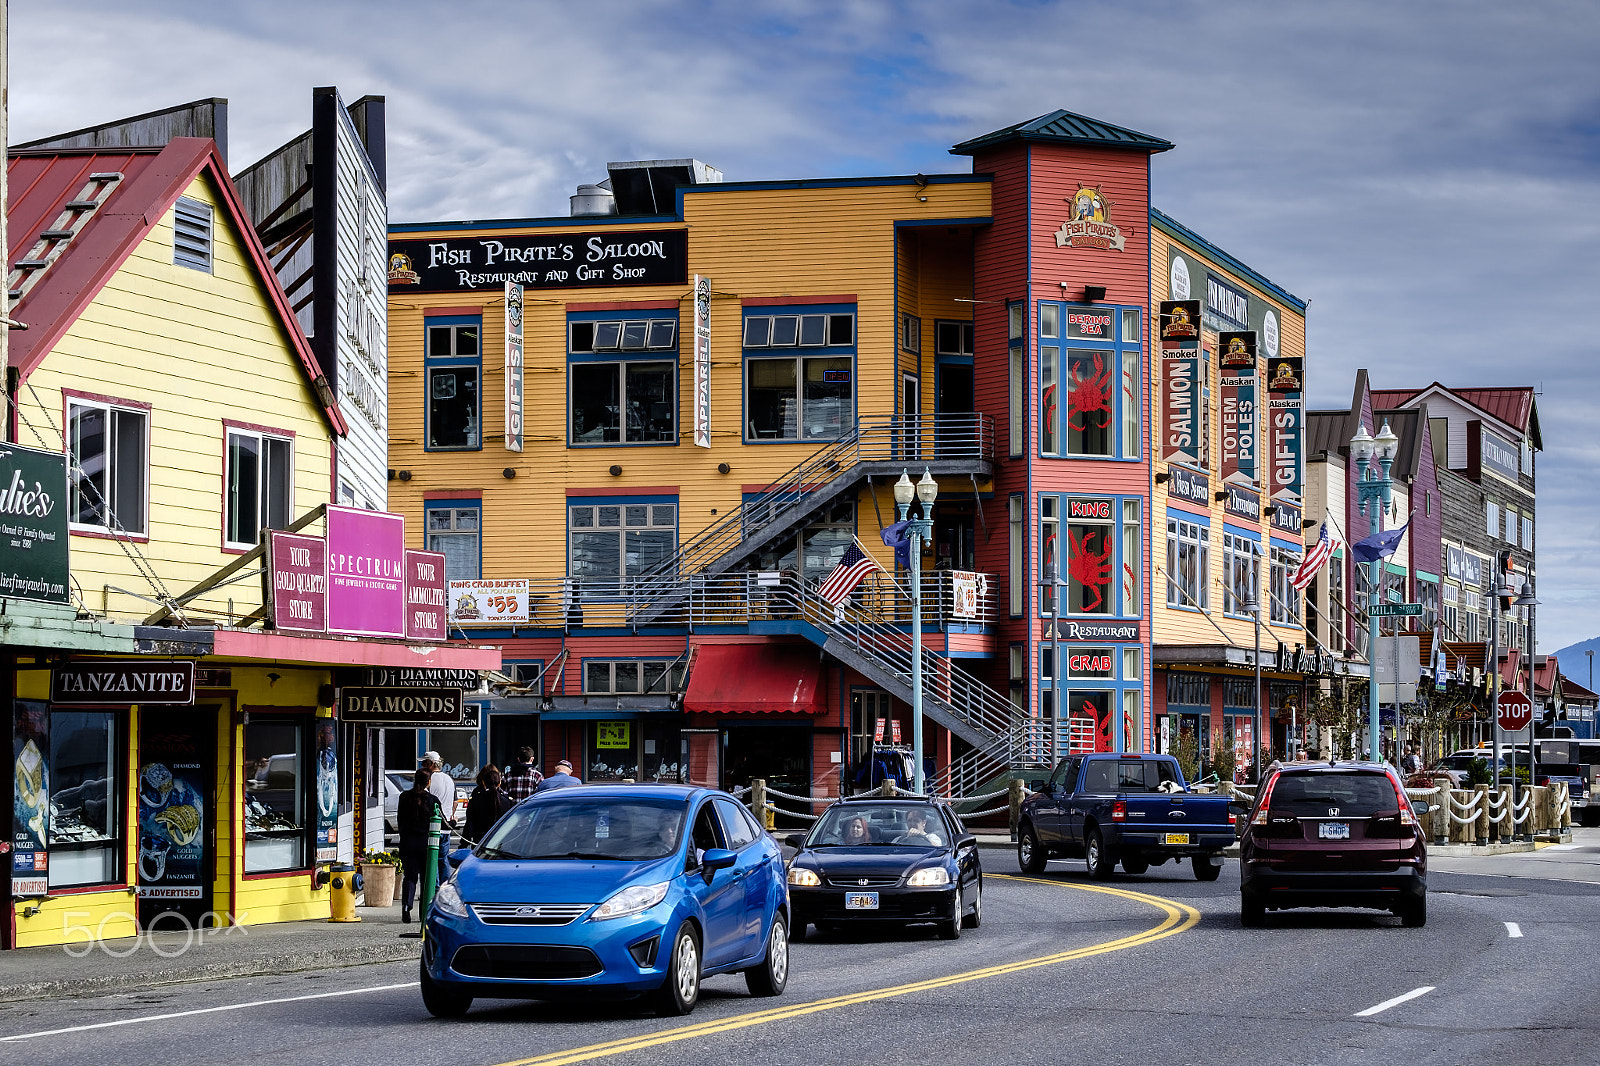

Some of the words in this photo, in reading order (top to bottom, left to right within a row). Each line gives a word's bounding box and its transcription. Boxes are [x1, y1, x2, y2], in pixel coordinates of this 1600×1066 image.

[428, 242, 472, 269] FISH
[480, 240, 574, 266] PIRATE'S
[586, 236, 667, 261] SALOON
[455, 268, 538, 289] RESTAURANT
[546, 269, 569, 281] AND
[576, 265, 607, 281] GIFT
[612, 263, 646, 281] SHOP
[1069, 314, 1110, 325] BERING
[1081, 323, 1102, 334] SEA
[1162, 350, 1197, 358] Smoked
[700, 341, 708, 434] APPAREL
[1220, 378, 1254, 386] Alaskan
[510, 350, 520, 435] GIFTS
[1170, 362, 1191, 447] SALMON
[1269, 400, 1300, 408] Alaskan
[1223, 397, 1237, 462] TOTEM
[1239, 400, 1252, 459] POLES
[1275, 412, 1295, 484] GIFTS
[1071, 501, 1110, 517] KING
[290, 547, 310, 567] YOUR
[330, 553, 402, 578] SPECTRUM
[416, 563, 435, 581] YOUR
[276, 571, 295, 591] GOLD
[296, 573, 324, 594] QUARTZ
[335, 577, 345, 586] FINE
[346, 579, 364, 588] JEWELRY
[369, 581, 385, 590] EXOTIC
[386, 582, 397, 591] GEMS
[408, 586, 443, 606] AMMOLITE
[488, 596, 518, 613] $55
[289, 600, 312, 619] STORE
[1372, 606, 1396, 615] MILL
[414, 612, 438, 630] STORE
[1066, 622, 1137, 639] RESTAURANT
[1070, 655, 1111, 671] CRAB
[60, 672, 185, 693] TANZANITE
[400, 670, 476, 680] DIAMONDS
[348, 697, 455, 713] DIAMONDS
[1498, 704, 1530, 718] STOP
[1329, 826, 1345, 835] SHOP
[13, 881, 18, 892] AS
[20, 881, 46, 892] ADVERTISED
